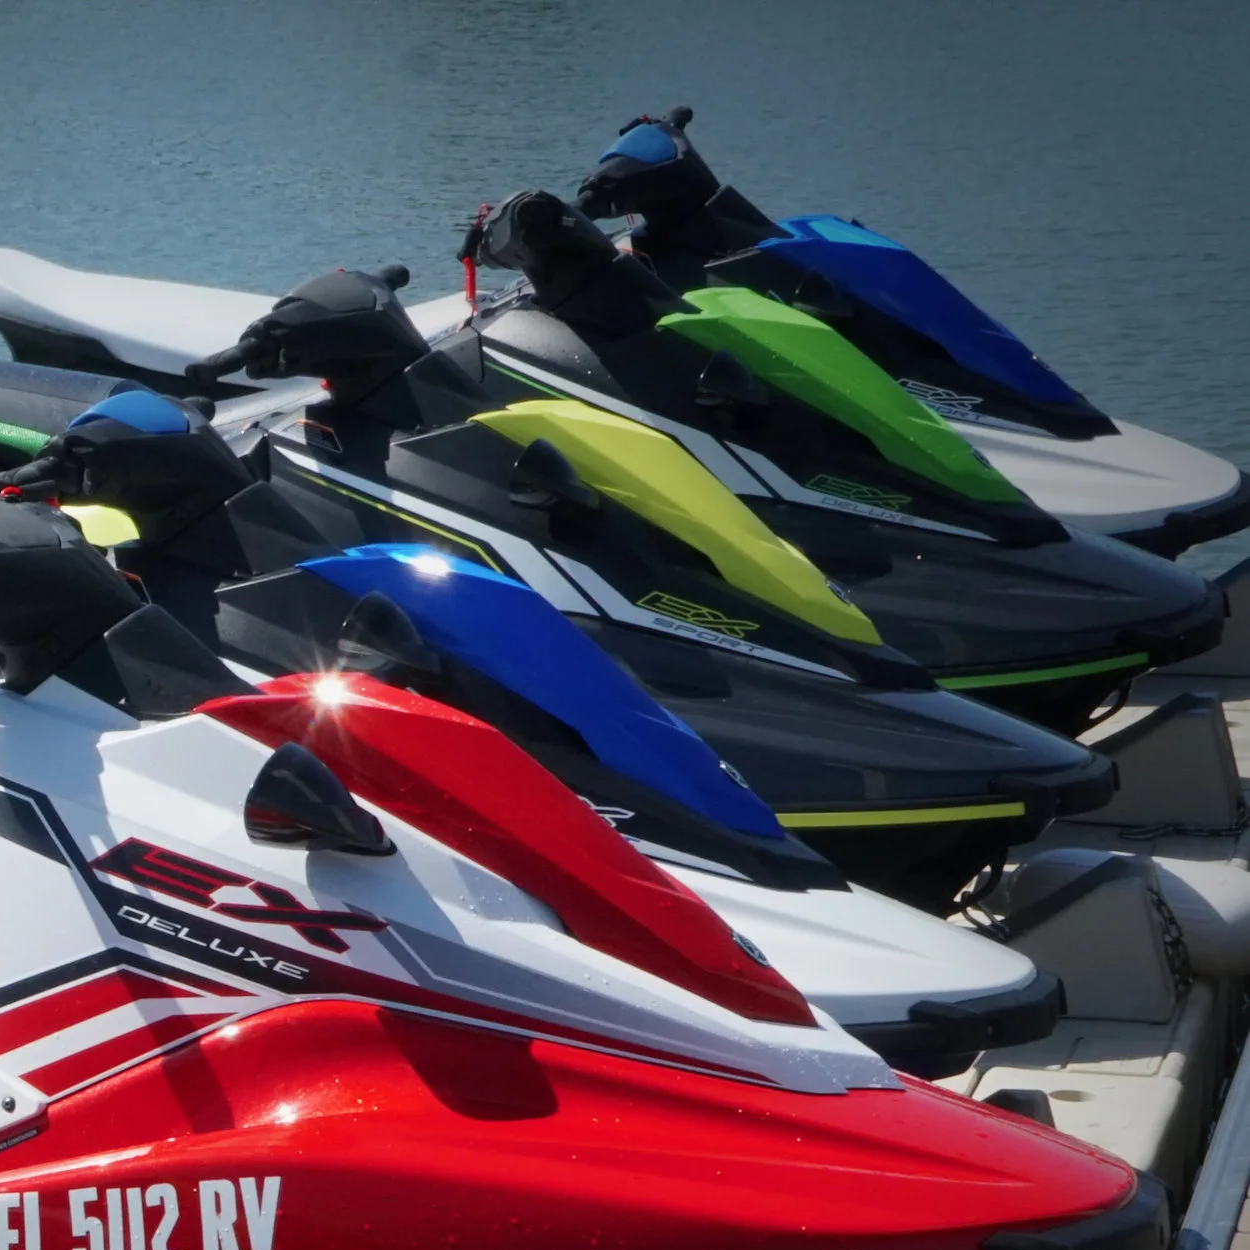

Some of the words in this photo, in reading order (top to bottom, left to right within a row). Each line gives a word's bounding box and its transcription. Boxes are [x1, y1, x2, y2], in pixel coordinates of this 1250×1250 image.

[805, 474, 913, 511] EX
[821, 496, 914, 525] DELUXE
[636, 591, 760, 638] EX
[653, 617, 765, 652] SPORT
[87, 837, 389, 954] EX
[118, 905, 309, 980] DELUXE
